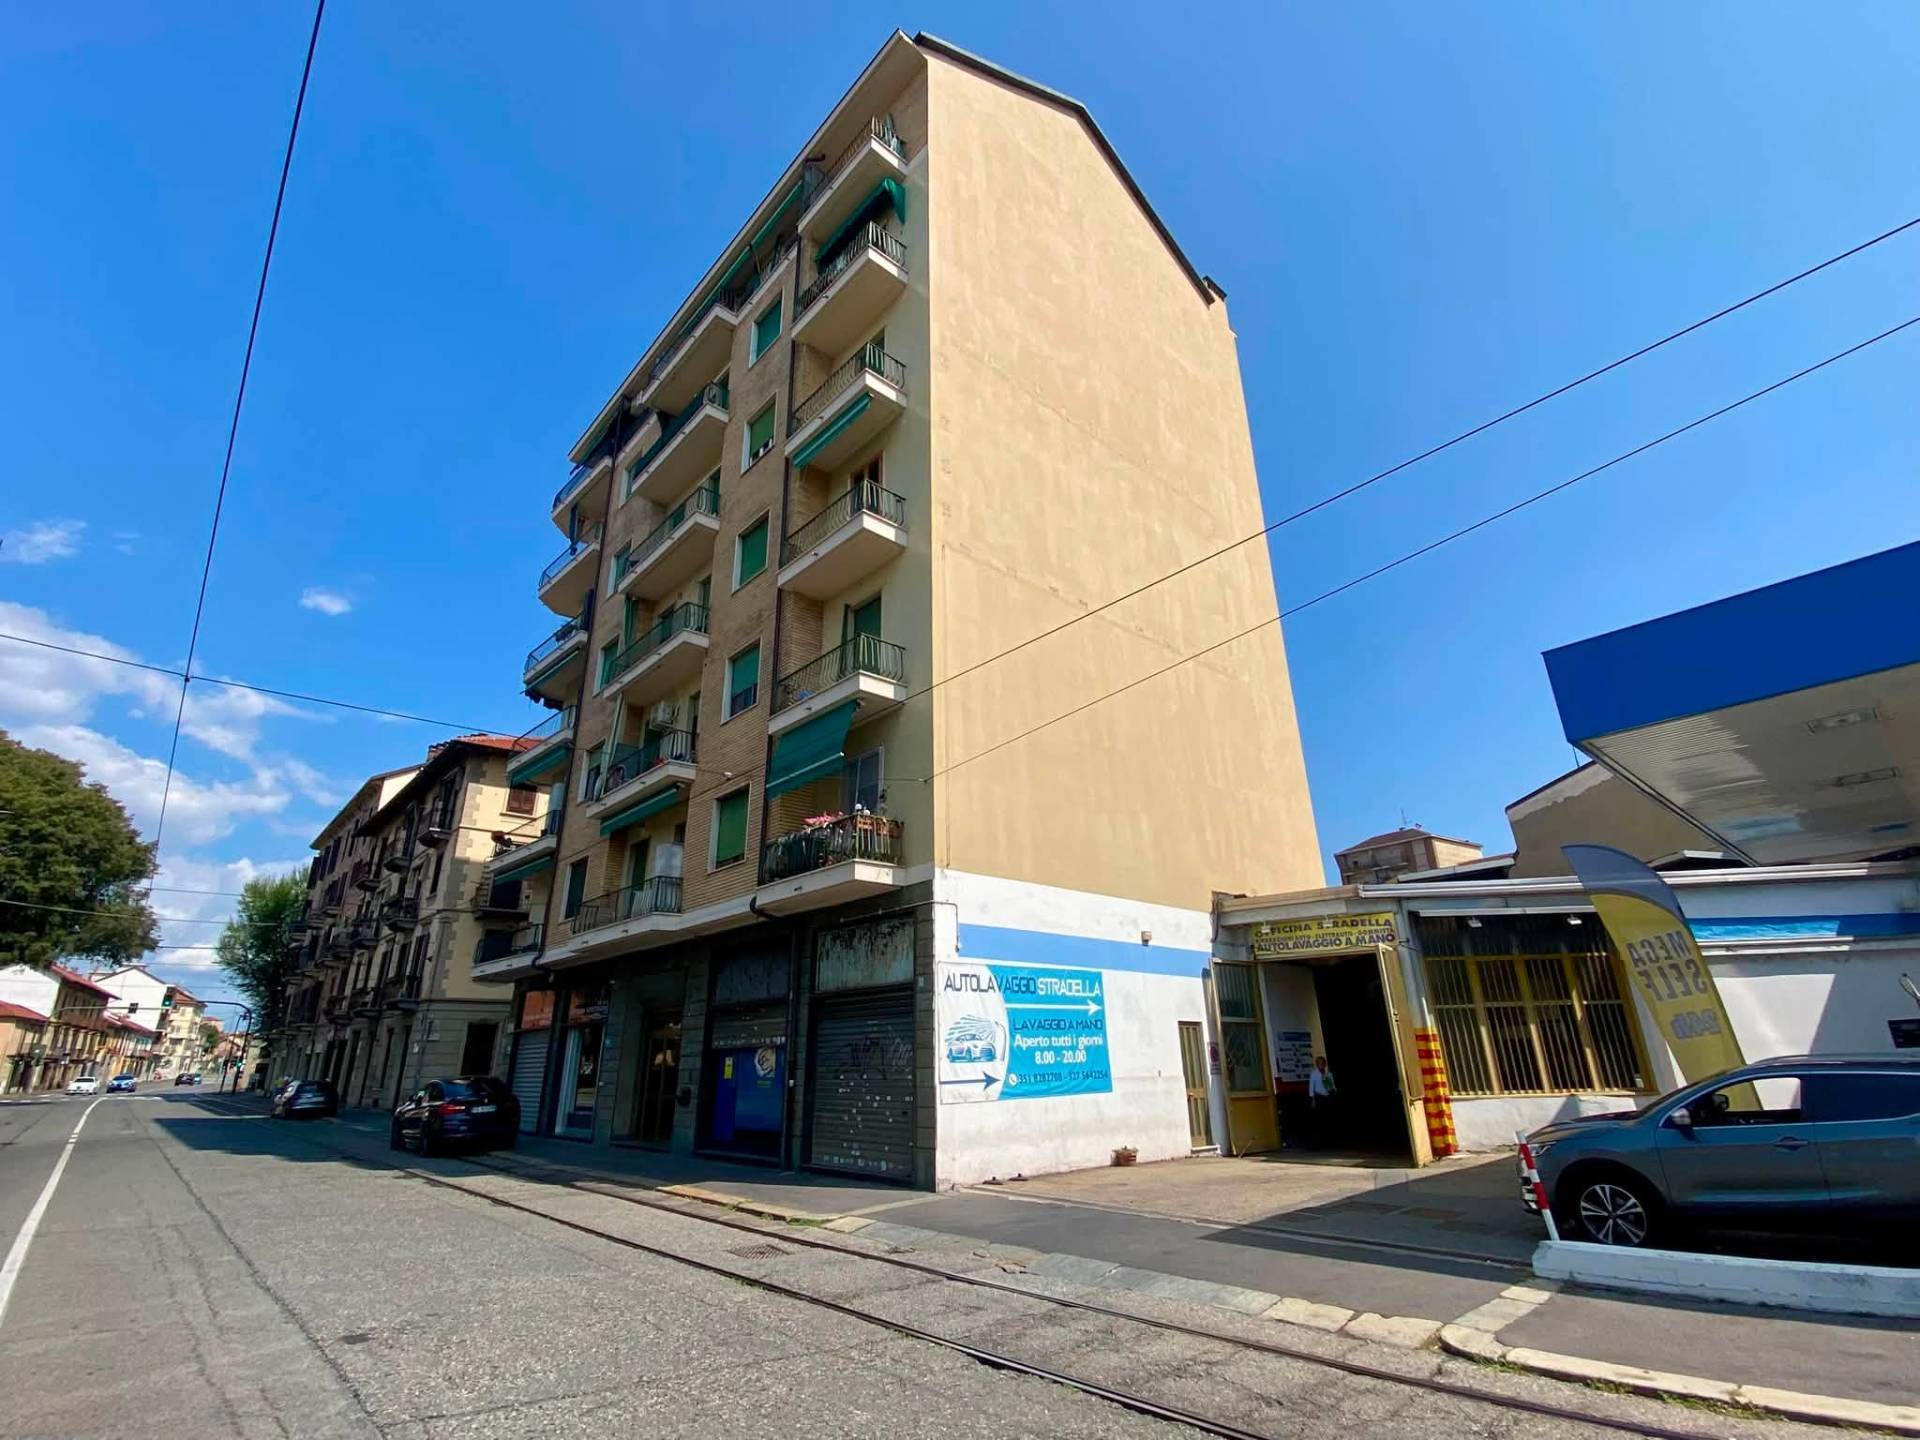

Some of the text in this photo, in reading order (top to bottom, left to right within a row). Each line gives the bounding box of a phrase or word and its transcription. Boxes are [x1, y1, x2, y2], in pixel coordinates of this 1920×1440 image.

[1255, 918, 1392, 937] OFICINA SRADELLA
[1257, 933, 1395, 952] AUTOLAVAGGIO A MANO
[944, 973, 1101, 997] AUTOLAVAGGIO STRADELLA
[1013, 1019, 1103, 1031] LAVAGGIO A MANO
[1014, 1034, 1050, 1051] Aperto
[1052, 1034, 1071, 1047] tutti
[1078, 1033, 1104, 1049] giorni
[1034, 1050, 1055, 1064] 8.00
[1062, 1050, 1087, 1064] 20.00
